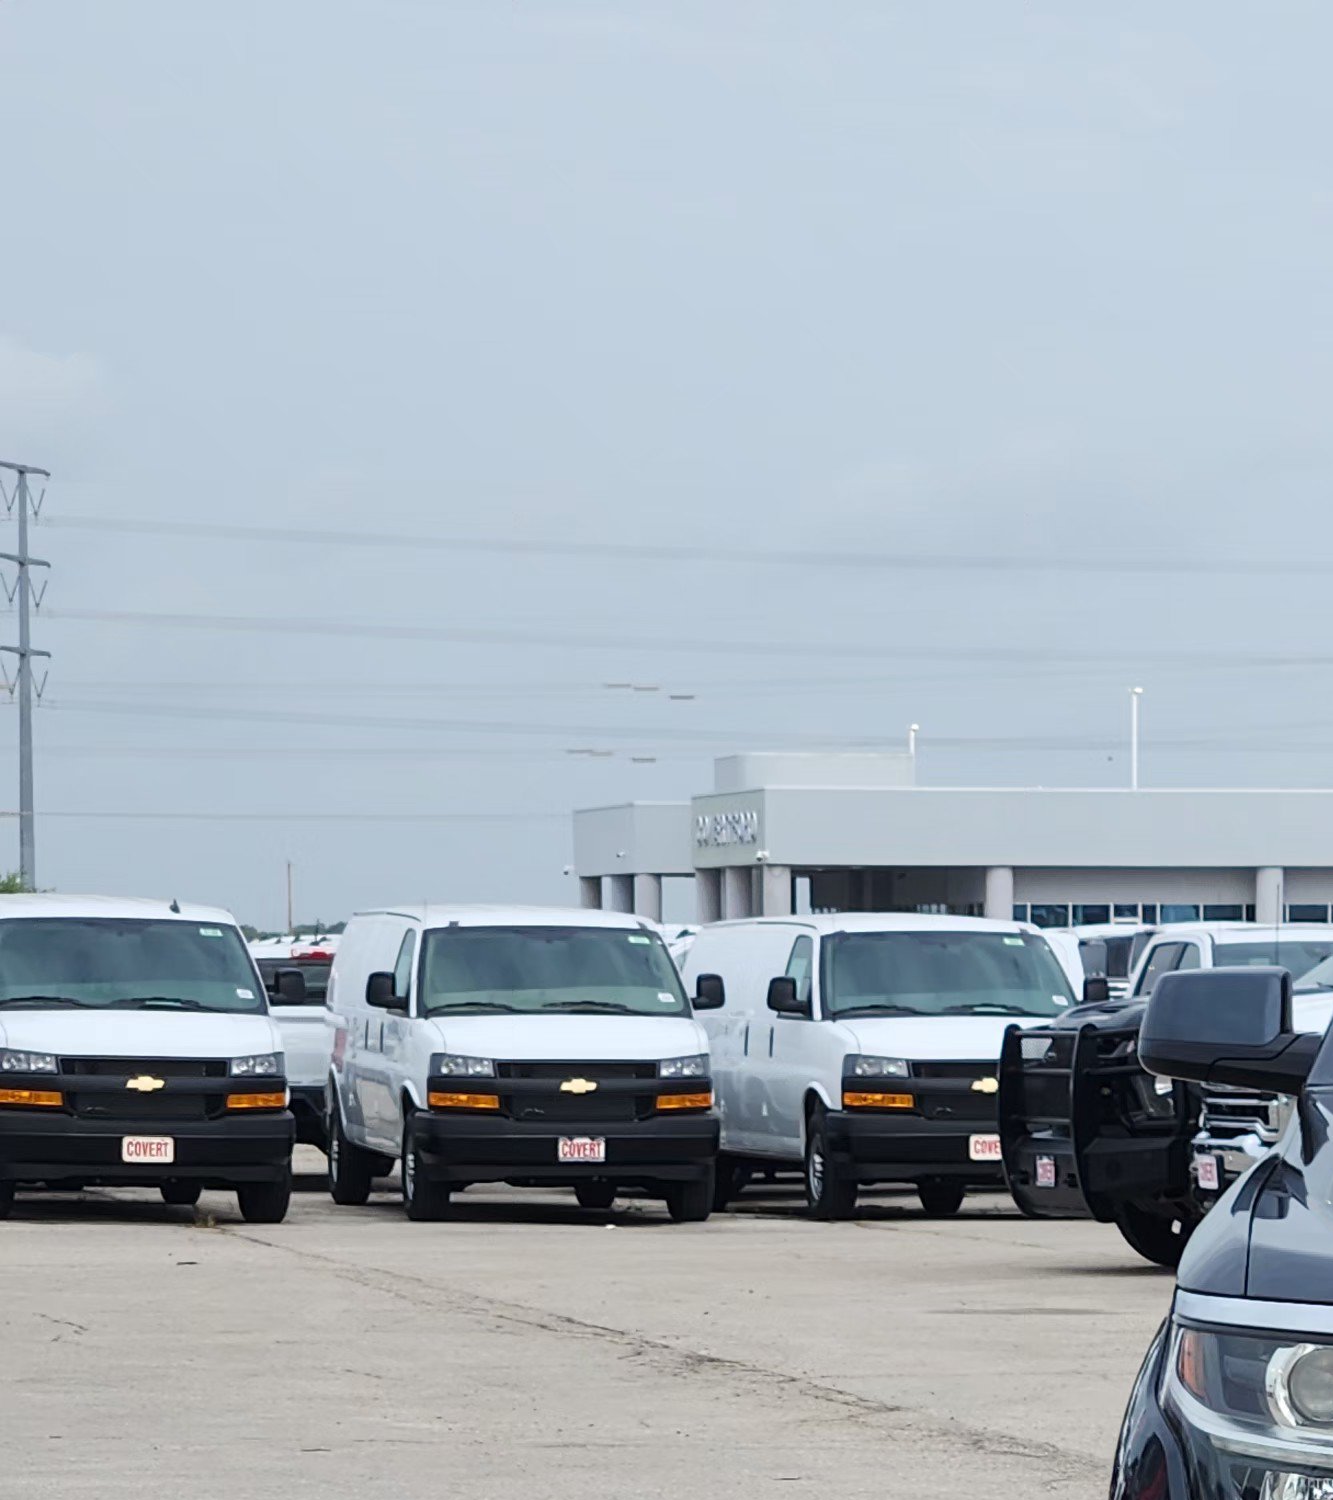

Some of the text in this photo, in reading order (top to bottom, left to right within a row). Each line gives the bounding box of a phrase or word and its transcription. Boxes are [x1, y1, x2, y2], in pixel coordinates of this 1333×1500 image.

[126, 1141, 169, 1158] COVERT
[561, 1141, 602, 1158] COVERT
[973, 1139, 1001, 1155] COVE
